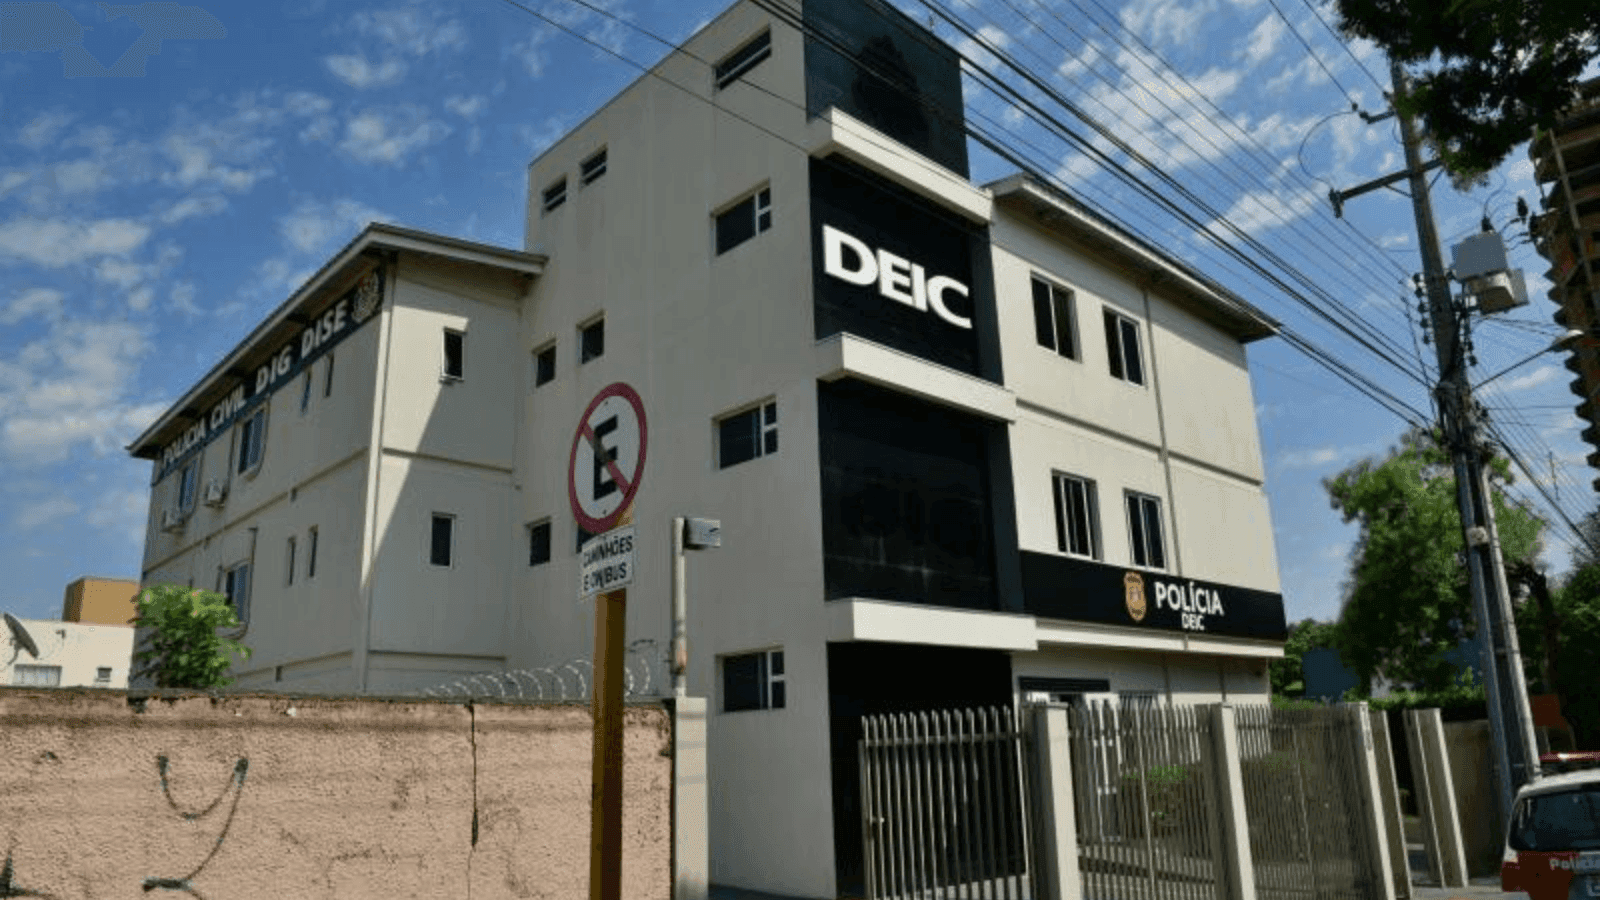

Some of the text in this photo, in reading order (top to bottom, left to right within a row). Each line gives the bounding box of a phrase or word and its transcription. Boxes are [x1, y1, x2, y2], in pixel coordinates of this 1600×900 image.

[822, 223, 973, 330] DEIC
[210, 384, 247, 431] CIVIL
[255, 344, 292, 395] DIG
[301, 299, 348, 360] DISE
[593, 413, 618, 501] E
[583, 572, 589, 592] E
[1154, 581, 1225, 616] POLÍCIA
[1181, 613, 1205, 631] DEIC
